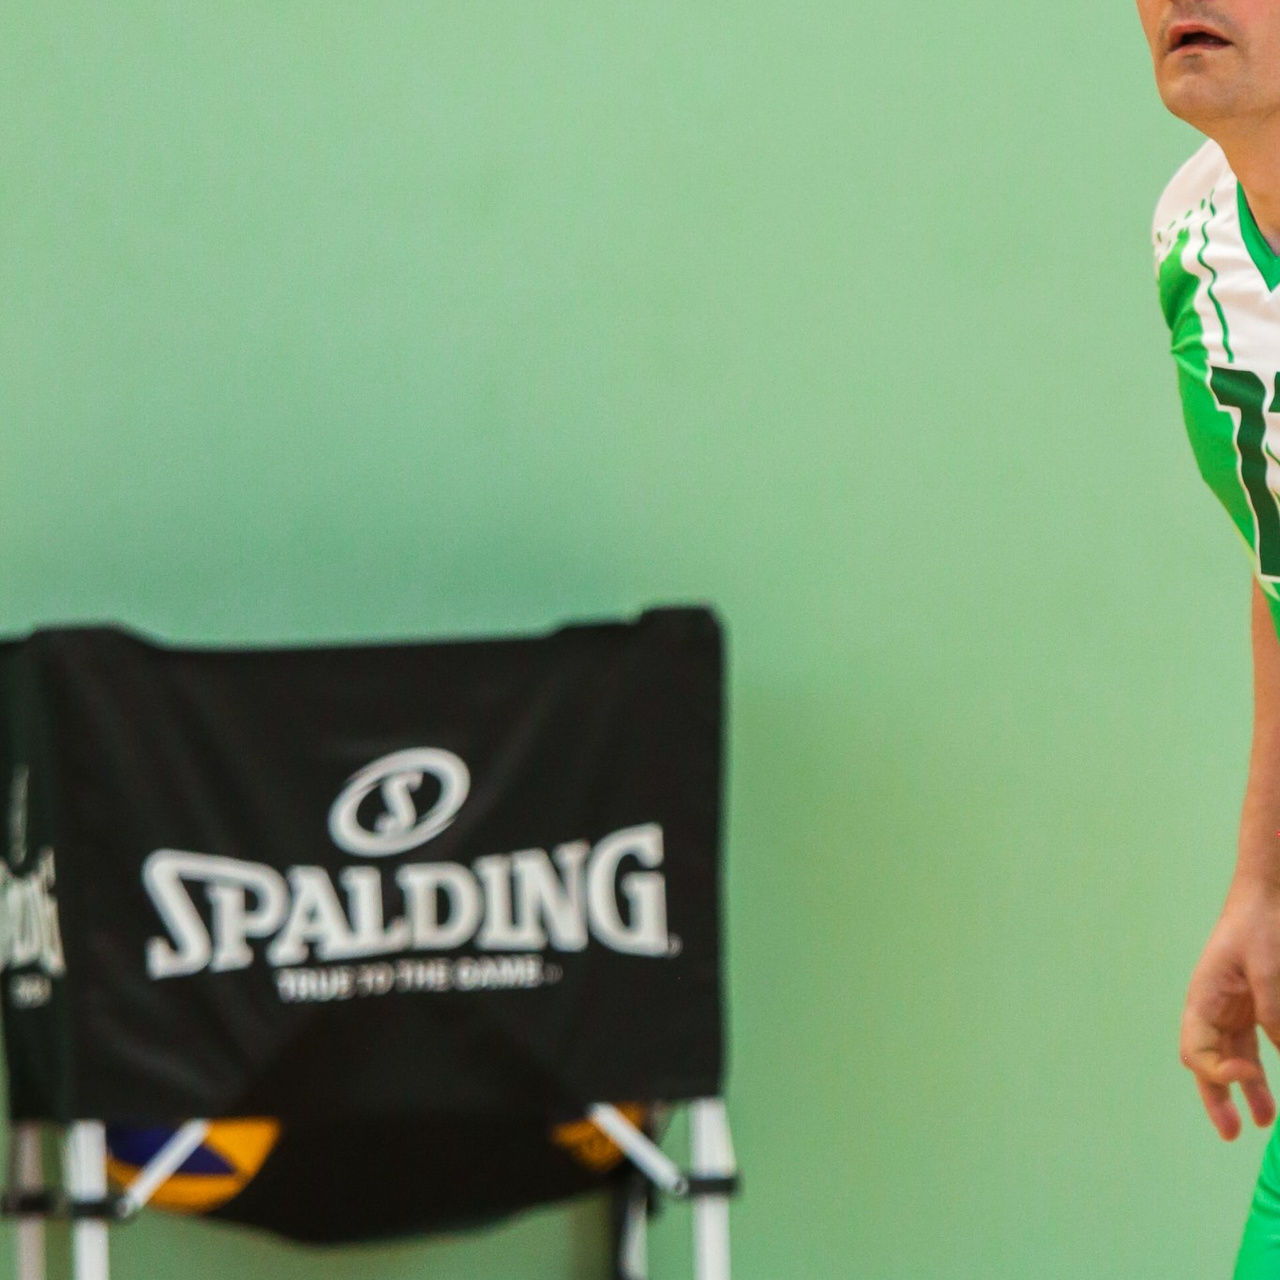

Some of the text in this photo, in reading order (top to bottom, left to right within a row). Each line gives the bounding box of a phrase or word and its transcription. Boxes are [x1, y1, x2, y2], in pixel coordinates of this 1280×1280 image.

[142, 822, 674, 981] SPALDING
[277, 966, 354, 1003] TRUE
[356, 962, 394, 997] TO
[396, 956, 451, 992] THE
